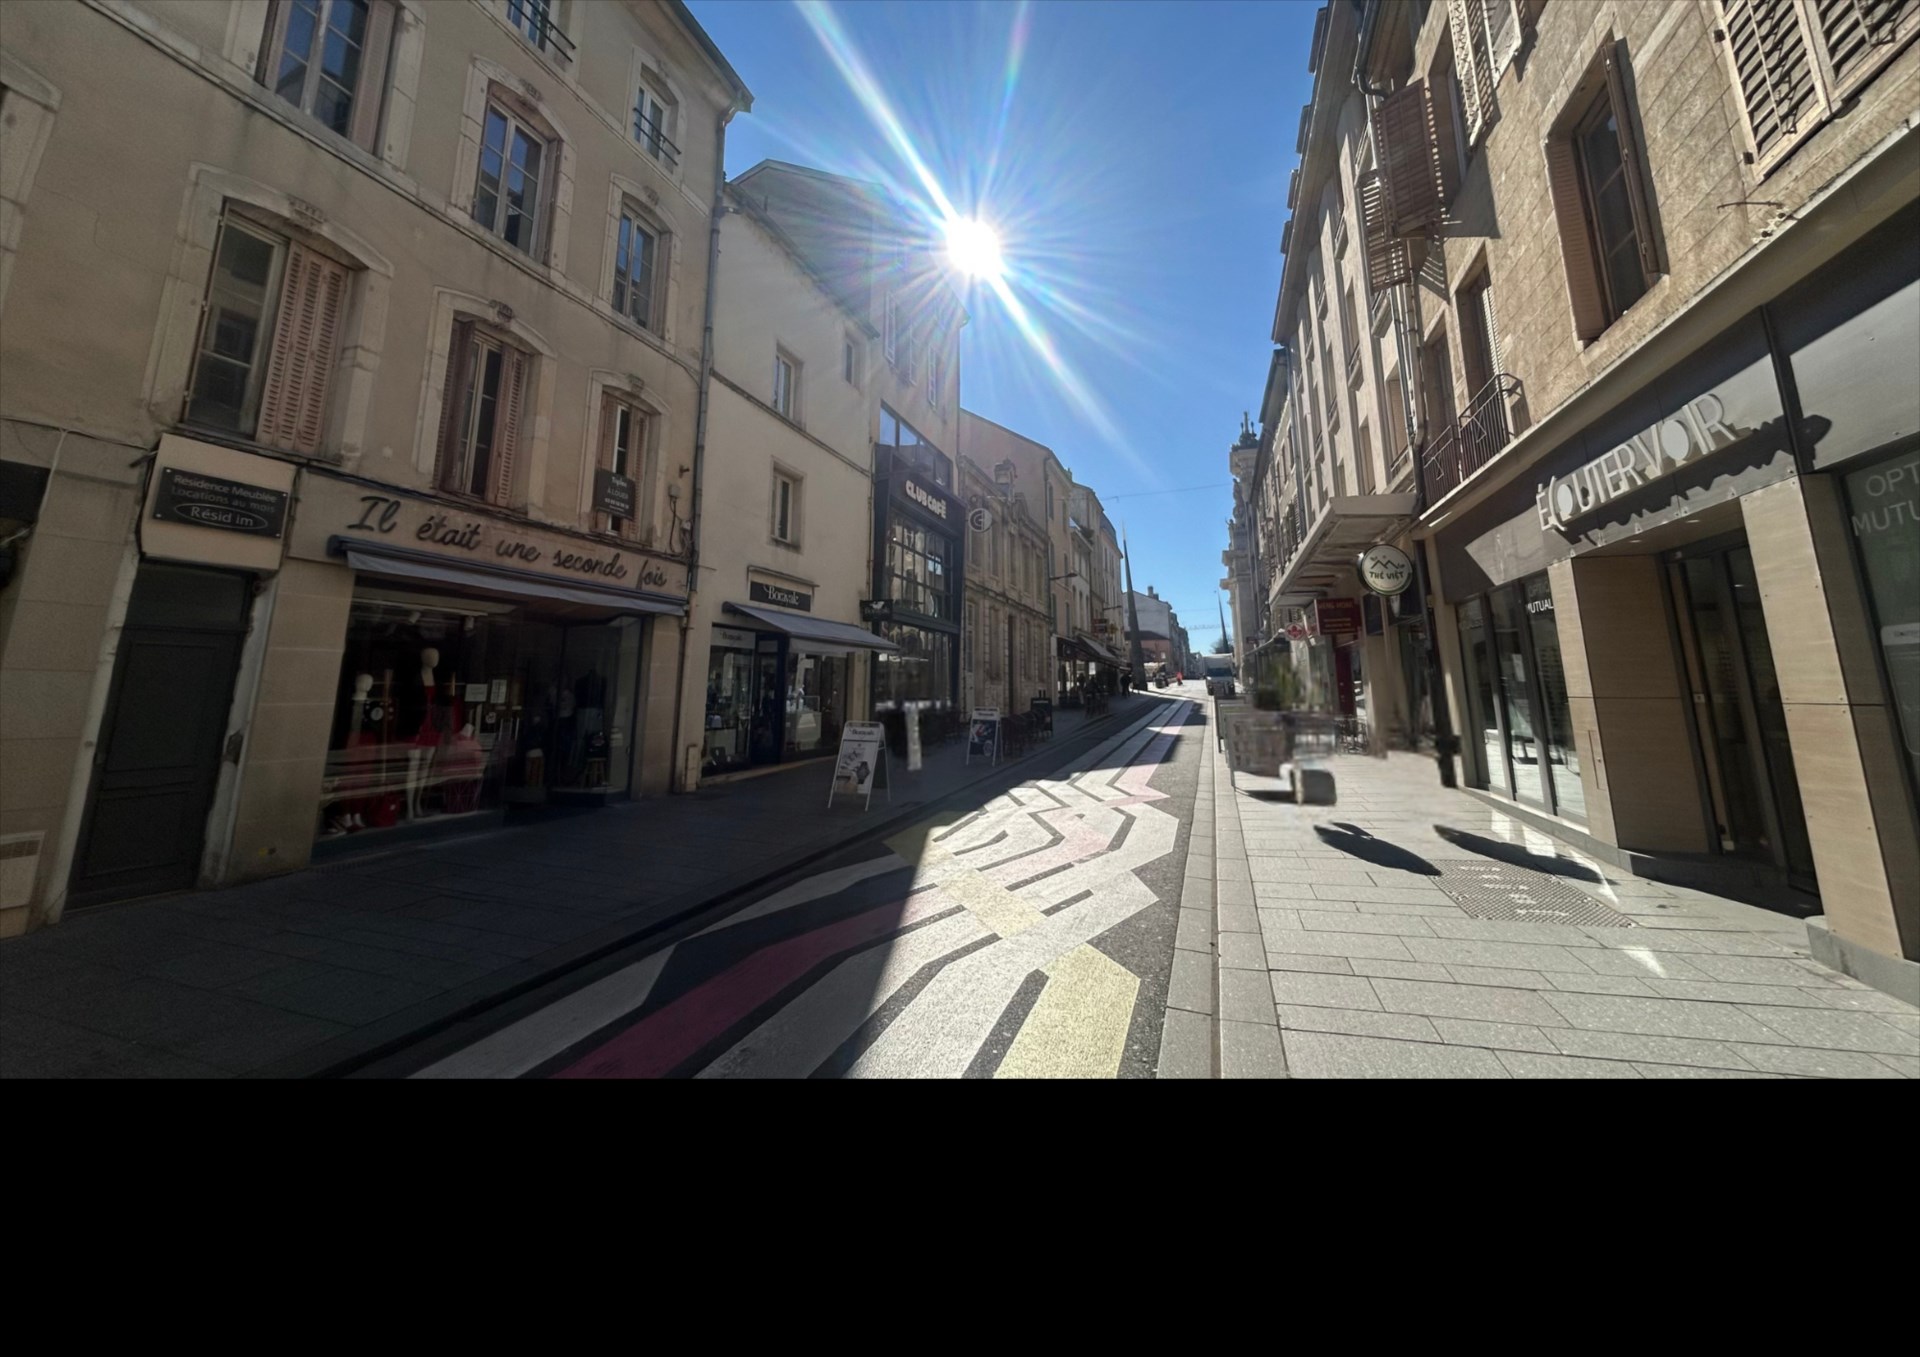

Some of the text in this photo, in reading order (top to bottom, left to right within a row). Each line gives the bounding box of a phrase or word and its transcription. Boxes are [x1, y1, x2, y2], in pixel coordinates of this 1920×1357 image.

[171, 486, 275, 514] Locations au mois
[905, 479, 927, 507] CLUB
[347, 495, 668, 590] Il était une seconde fois
